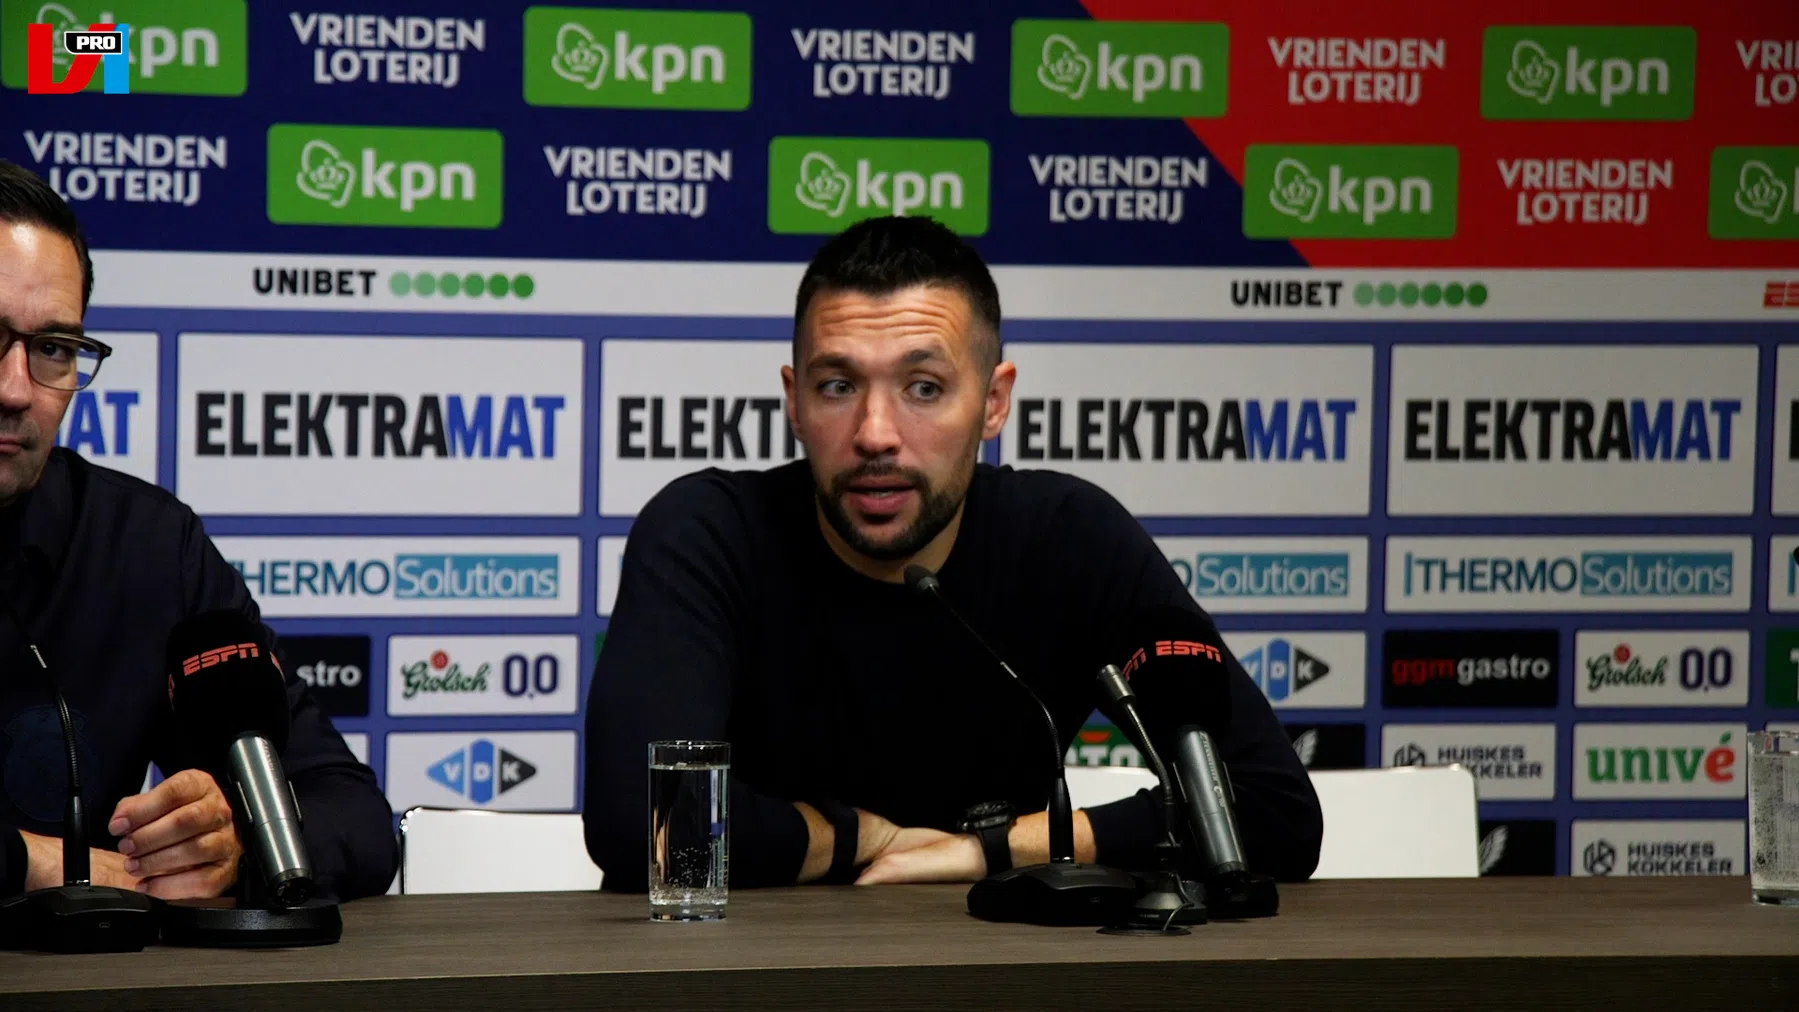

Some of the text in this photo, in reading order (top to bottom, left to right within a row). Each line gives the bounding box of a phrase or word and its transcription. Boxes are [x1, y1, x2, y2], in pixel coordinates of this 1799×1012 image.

[100, 12, 219, 78] pn
[291, 13, 485, 51] VRIENDEN
[792, 29, 974, 62] VRIENDEN
[315, 50, 459, 88] LOTERIJ
[614, 31, 725, 94] kpn
[1268, 38, 1445, 69] VRIENDEN
[813, 63, 949, 99] LOTERIJ
[1097, 41, 1202, 103] kpn
[1288, 71, 1420, 105] LOTERIJ
[1565, 47, 1670, 106] kpn
[24, 131, 227, 169] VRIENDEN
[544, 146, 731, 181] VRIENDEN
[50, 167, 200, 206] LOTERIJ
[361, 148, 476, 212] kpn
[856, 159, 963, 217] kpn
[1029, 155, 1207, 187] VRIENDEN
[1498, 159, 1673, 189] VRIENDEN
[567, 181, 706, 218] LOTERIJ
[1050, 188, 1183, 223] LOTERIJ
[1328, 164, 1432, 225] kpn
[1517, 192, 1648, 225] LOTERIJ
[253, 268, 377, 296] UNIBET
[1231, 281, 1343, 307] UNIBET
[195, 391, 565, 459] ELEKTRAMAT
[1017, 398, 1357, 462] ELEKTRAMAT
[1404, 398, 1742, 462] ELEKTRAMAT
[183, 642, 259, 676] ESPN
[1155, 640, 1221, 663] ESPN
[401, 661, 490, 699] Grolsch
[1586, 653, 1668, 691] Grolsch
[1438, 745, 1525, 761] HUISKES
[1465, 762, 1542, 779] KKELER
[1587, 731, 1736, 783] univé
[442, 762, 521, 782] VDK
[1627, 842, 1715, 858] HUISKES
[1627, 859, 1733, 875] KOKKELER
